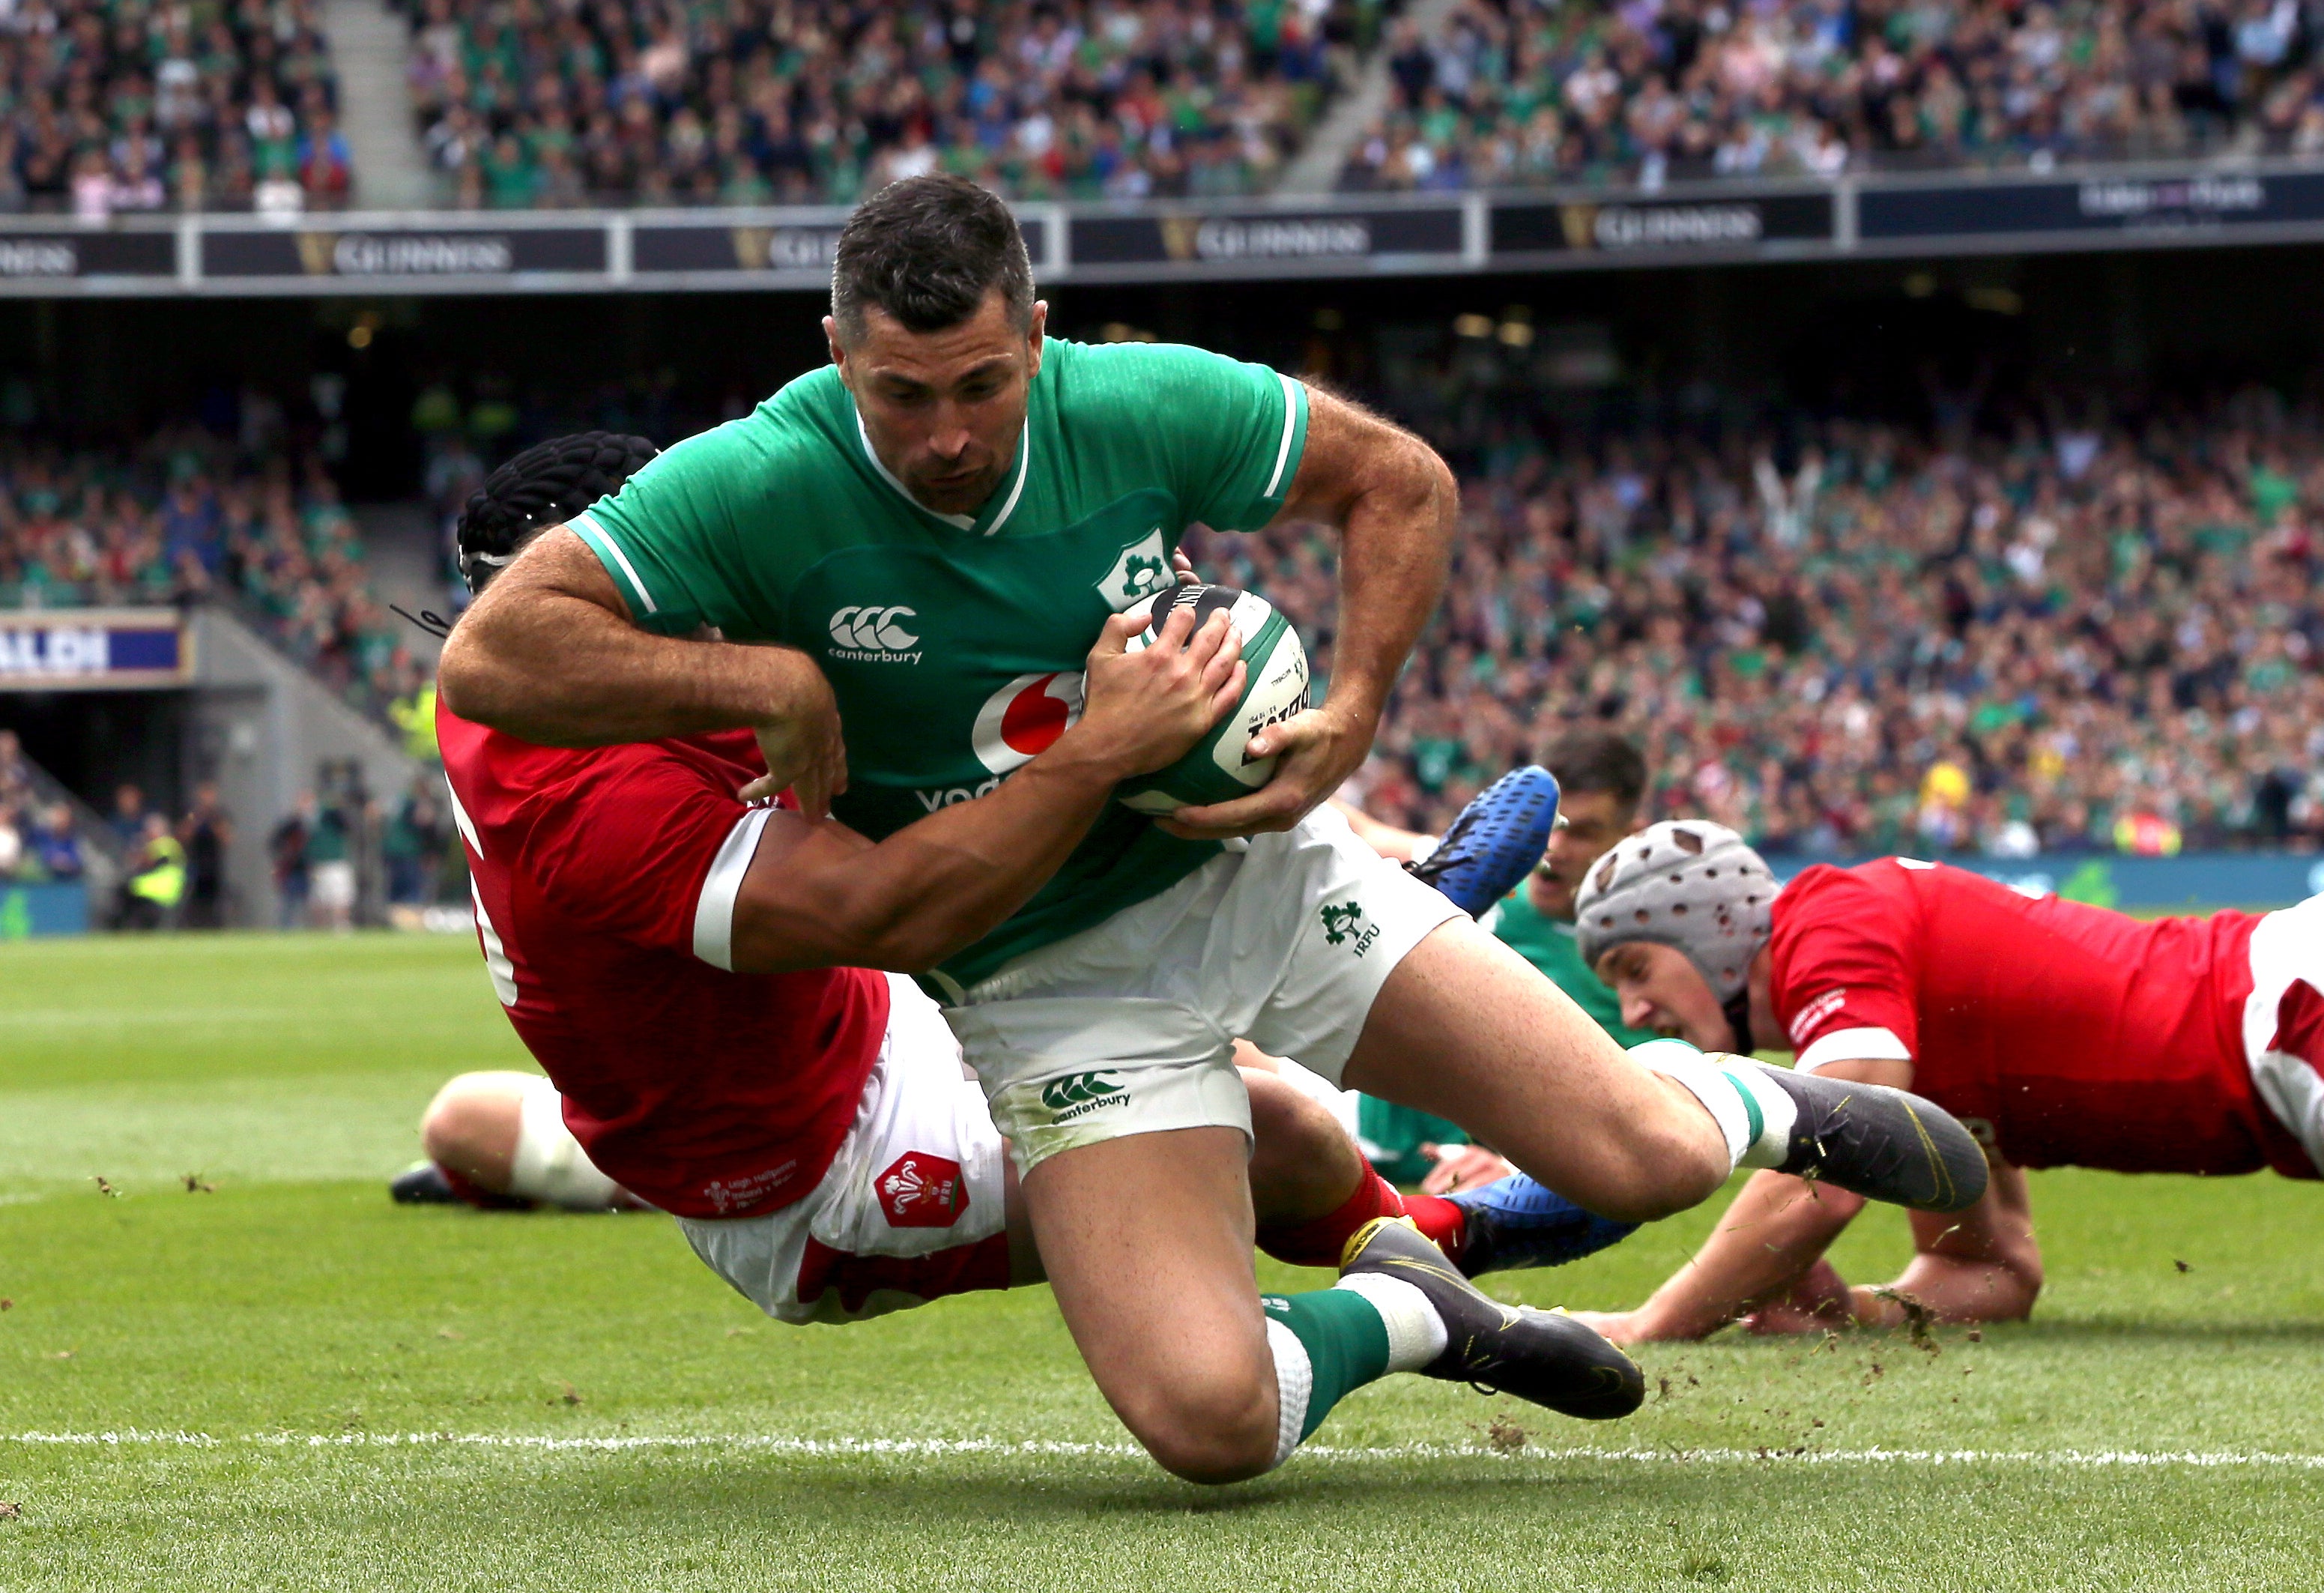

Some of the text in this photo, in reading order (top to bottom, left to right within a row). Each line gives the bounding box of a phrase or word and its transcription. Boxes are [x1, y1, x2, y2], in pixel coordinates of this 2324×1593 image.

[1196, 220, 1370, 256] GUINNESS
[1593, 206, 1761, 249] GUINNESS
[334, 234, 512, 272] GUINNESS
[769, 229, 838, 267] GUI
[828, 647, 923, 665] canterbury
[915, 774, 1008, 813] vod
[1353, 923, 1380, 958] IRFU
[1050, 1093, 1131, 1125] canterbury
[939, 1180, 952, 1205] WRU
